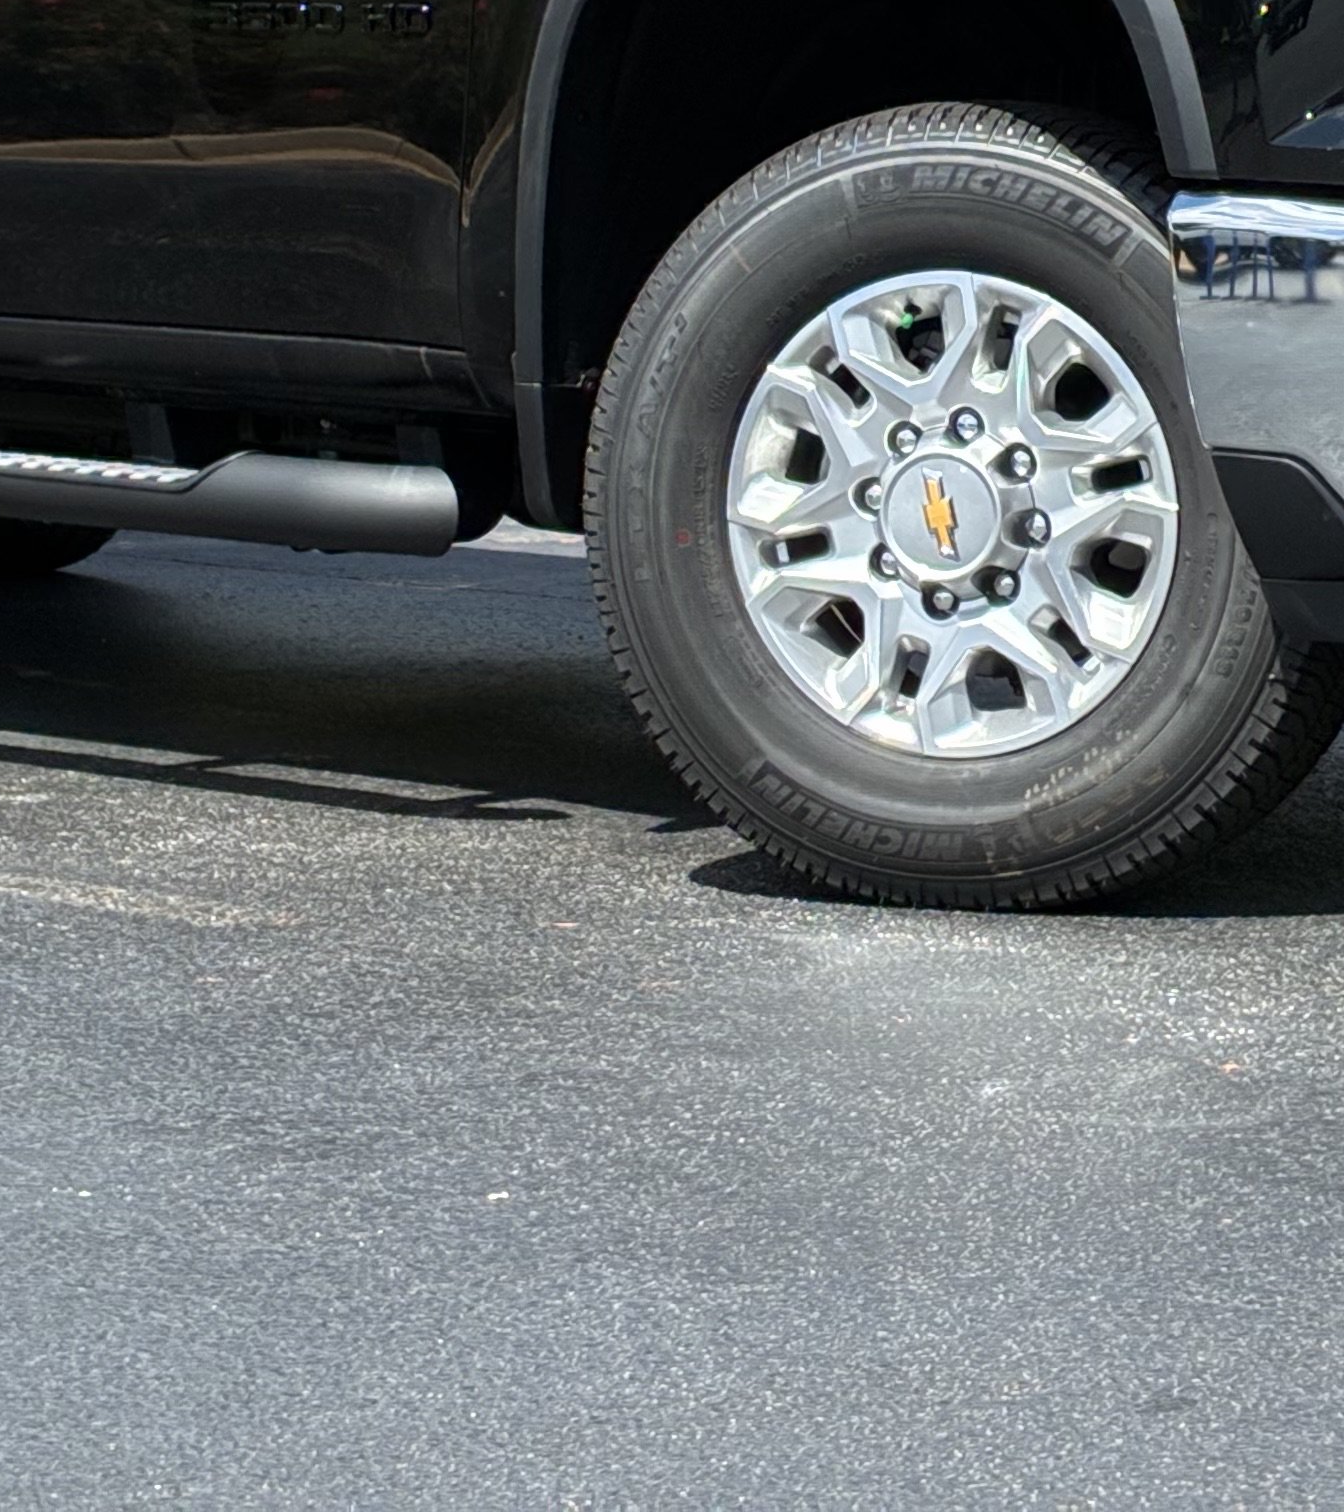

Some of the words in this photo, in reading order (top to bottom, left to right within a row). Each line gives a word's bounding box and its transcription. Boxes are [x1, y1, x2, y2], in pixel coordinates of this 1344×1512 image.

[360, 0, 434, 34] HD
[909, 163, 1130, 249] MICHELIN
[746, 770, 967, 863] MICHELIN
